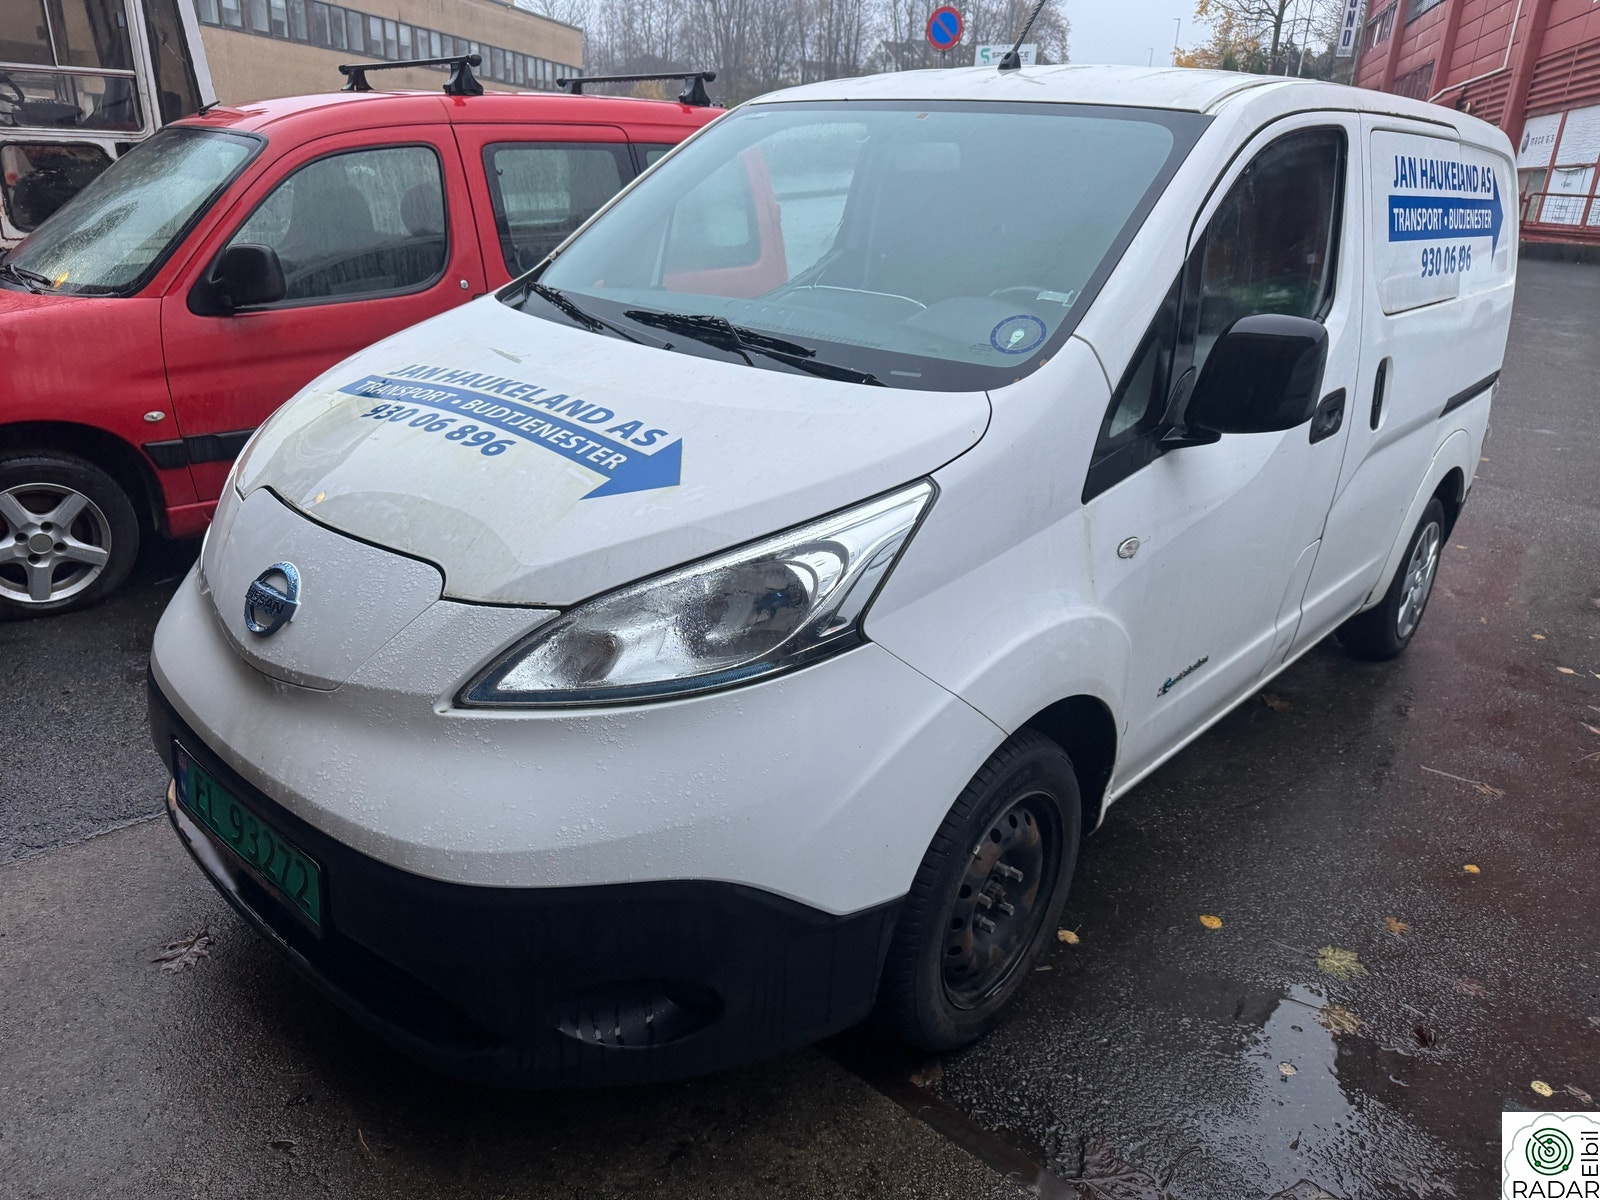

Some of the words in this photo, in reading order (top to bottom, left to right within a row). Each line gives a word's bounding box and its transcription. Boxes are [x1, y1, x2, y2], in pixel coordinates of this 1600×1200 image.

[1393, 155, 1417, 189] JAN
[1481, 166, 1491, 193] AS
[1393, 207, 1443, 232] TRANSPORT
[1421, 247, 1442, 278] 930
[1444, 245, 1456, 274] 06
[355, 380, 458, 404] TRANSPORT
[462, 398, 628, 470] BUDTJENESTER
[361, 402, 409, 424] 930
[408, 413, 449, 432] 06
[444, 424, 517, 457] 896
[387, 364, 440, 382] JAN
[441, 369, 615, 425] HAUKELAND
[605, 420, 669, 447] AS
[195, 771, 219, 828] EL
[229, 803, 312, 911] 93272
